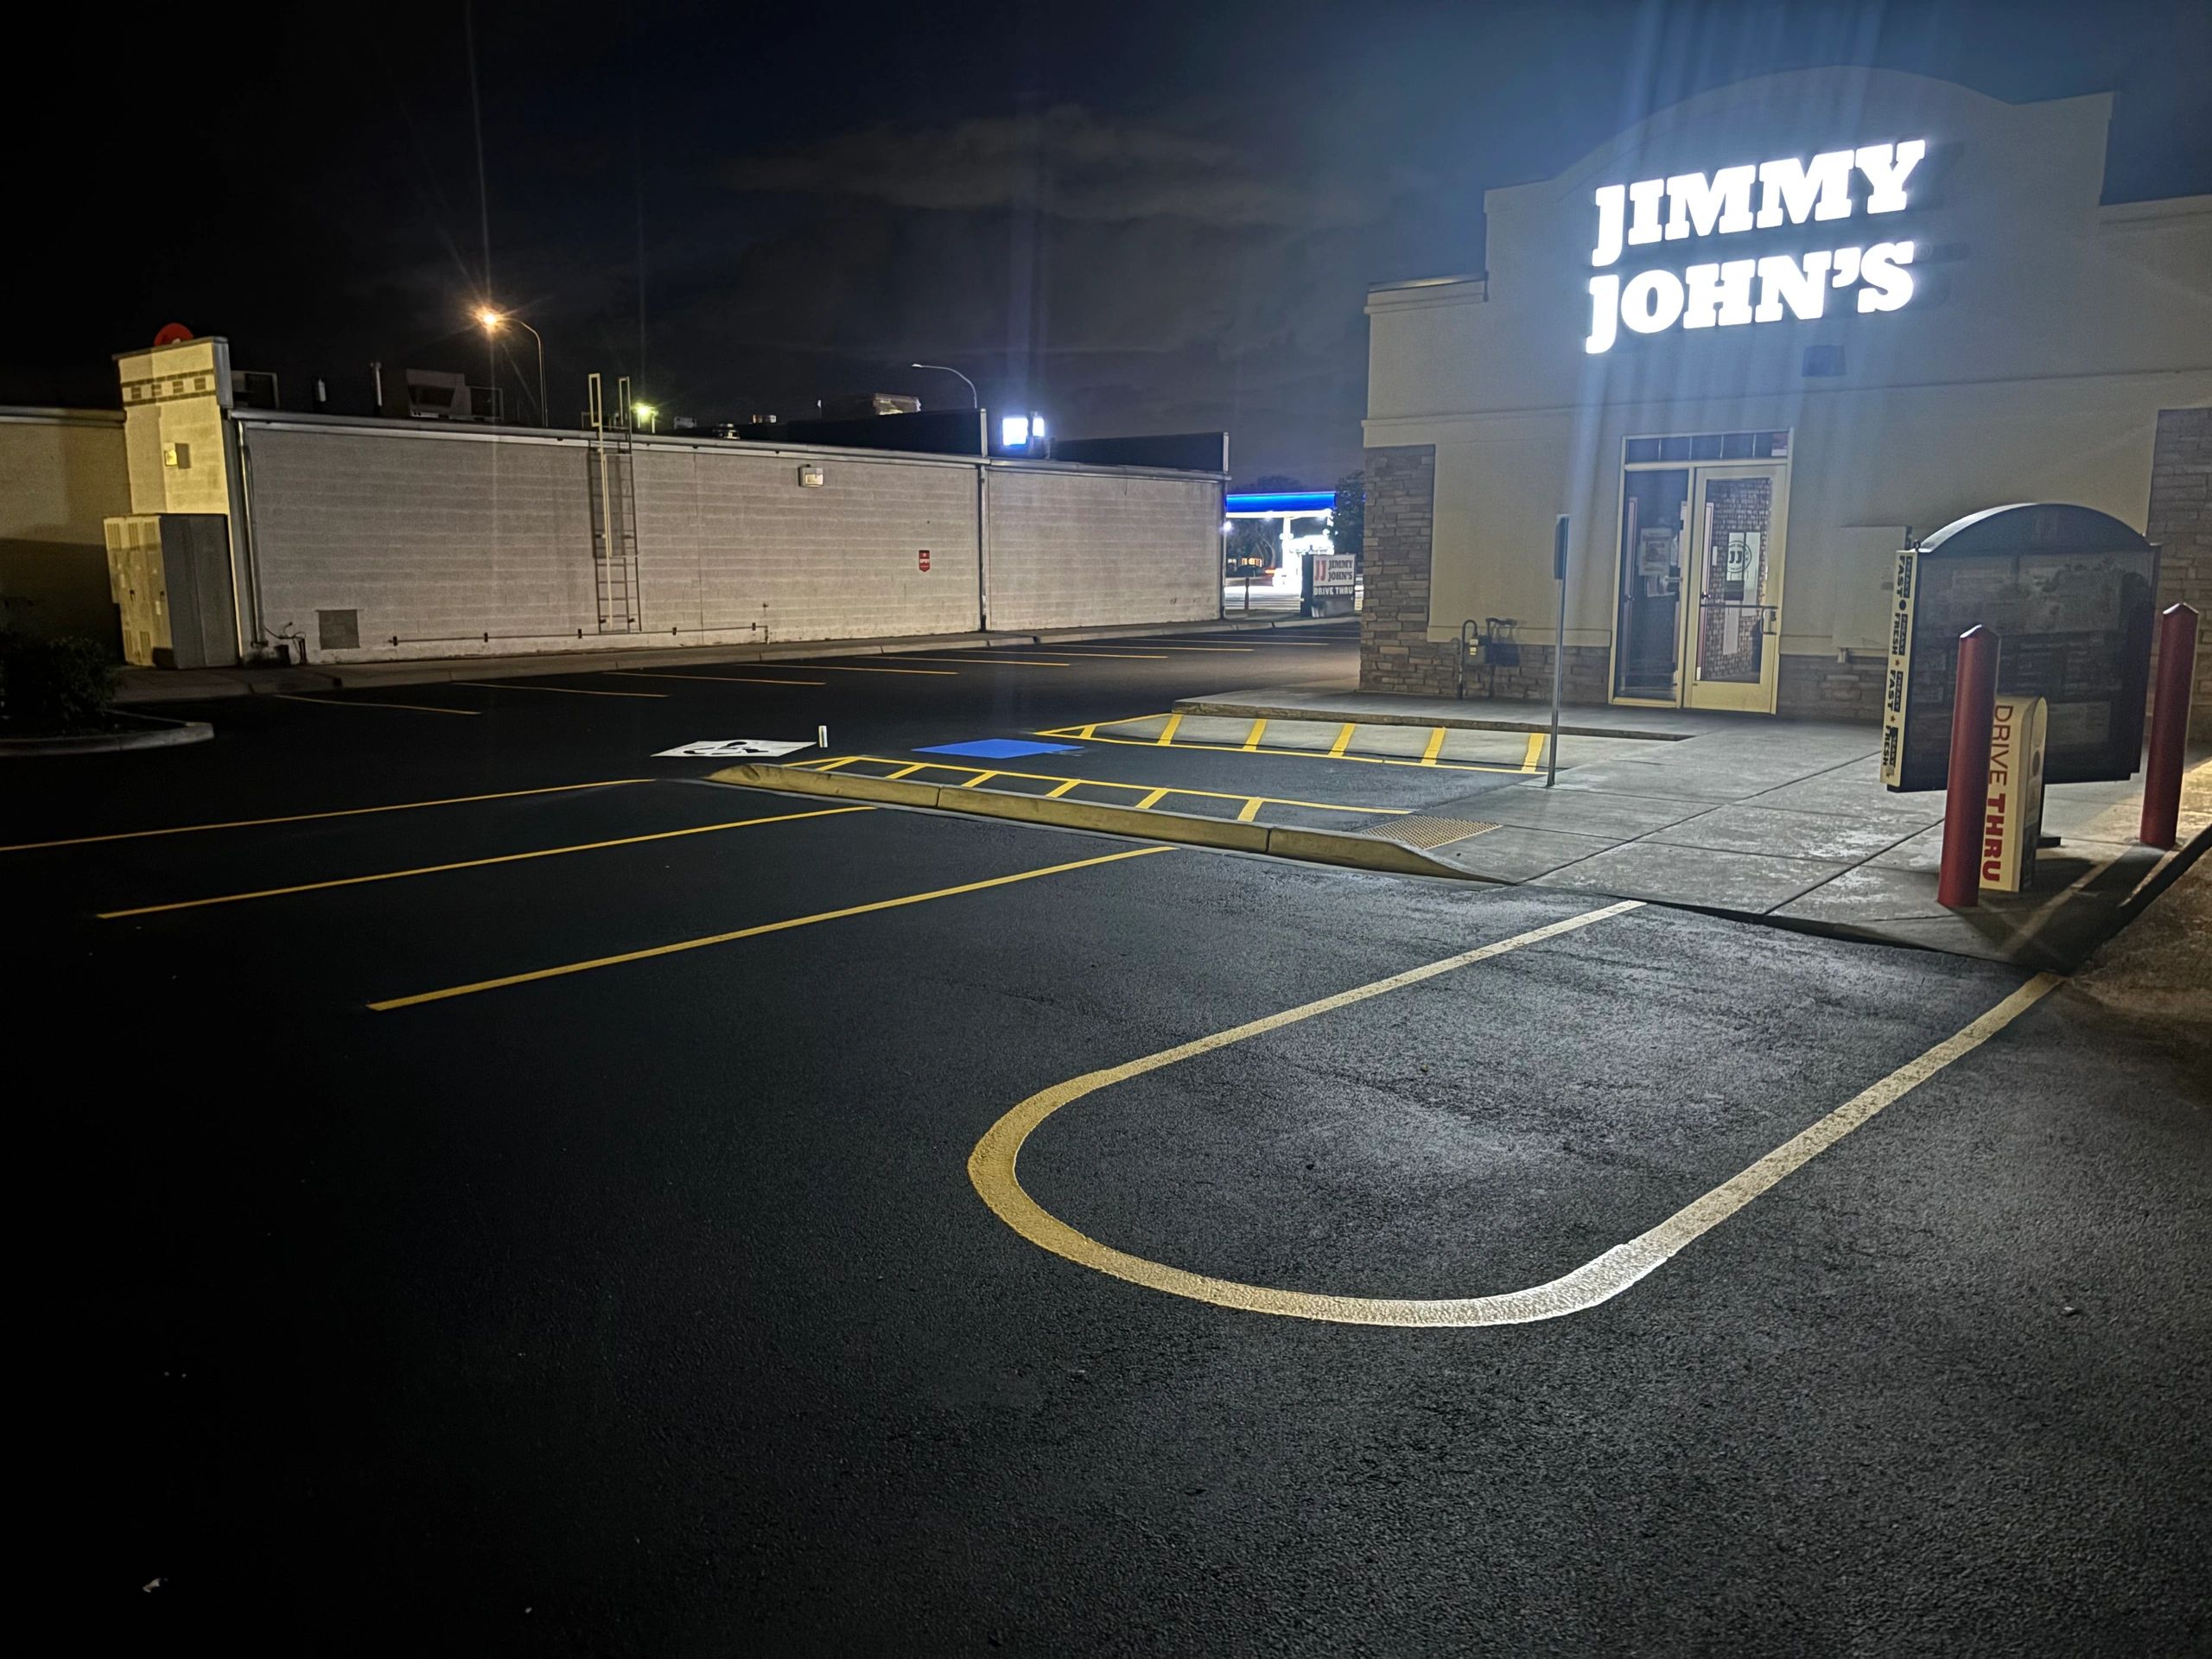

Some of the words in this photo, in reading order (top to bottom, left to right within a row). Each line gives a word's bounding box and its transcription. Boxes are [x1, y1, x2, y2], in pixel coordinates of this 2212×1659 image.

[1592, 139, 1926, 267] JIMMY
[1586, 241, 1915, 354] JOHN'S
[1314, 560, 1327, 581] JJ
[1328, 560, 1354, 570] JIMMY
[1328, 571, 1353, 582] JOHN'S
[1897, 556, 1905, 598] FAST
[1904, 556, 1913, 598] FREAKY
[1313, 587, 1334, 595] DRIVE
[1335, 586, 1354, 594] THRU
[1898, 613, 1908, 656] FREAKY
[1887, 670, 1896, 711] FAST
[1894, 671, 1904, 712] FREAKY
[1883, 725, 1891, 766] FRESH
[1988, 705, 2013, 786] DRIVE
[1982, 793, 2005, 882] THRU
